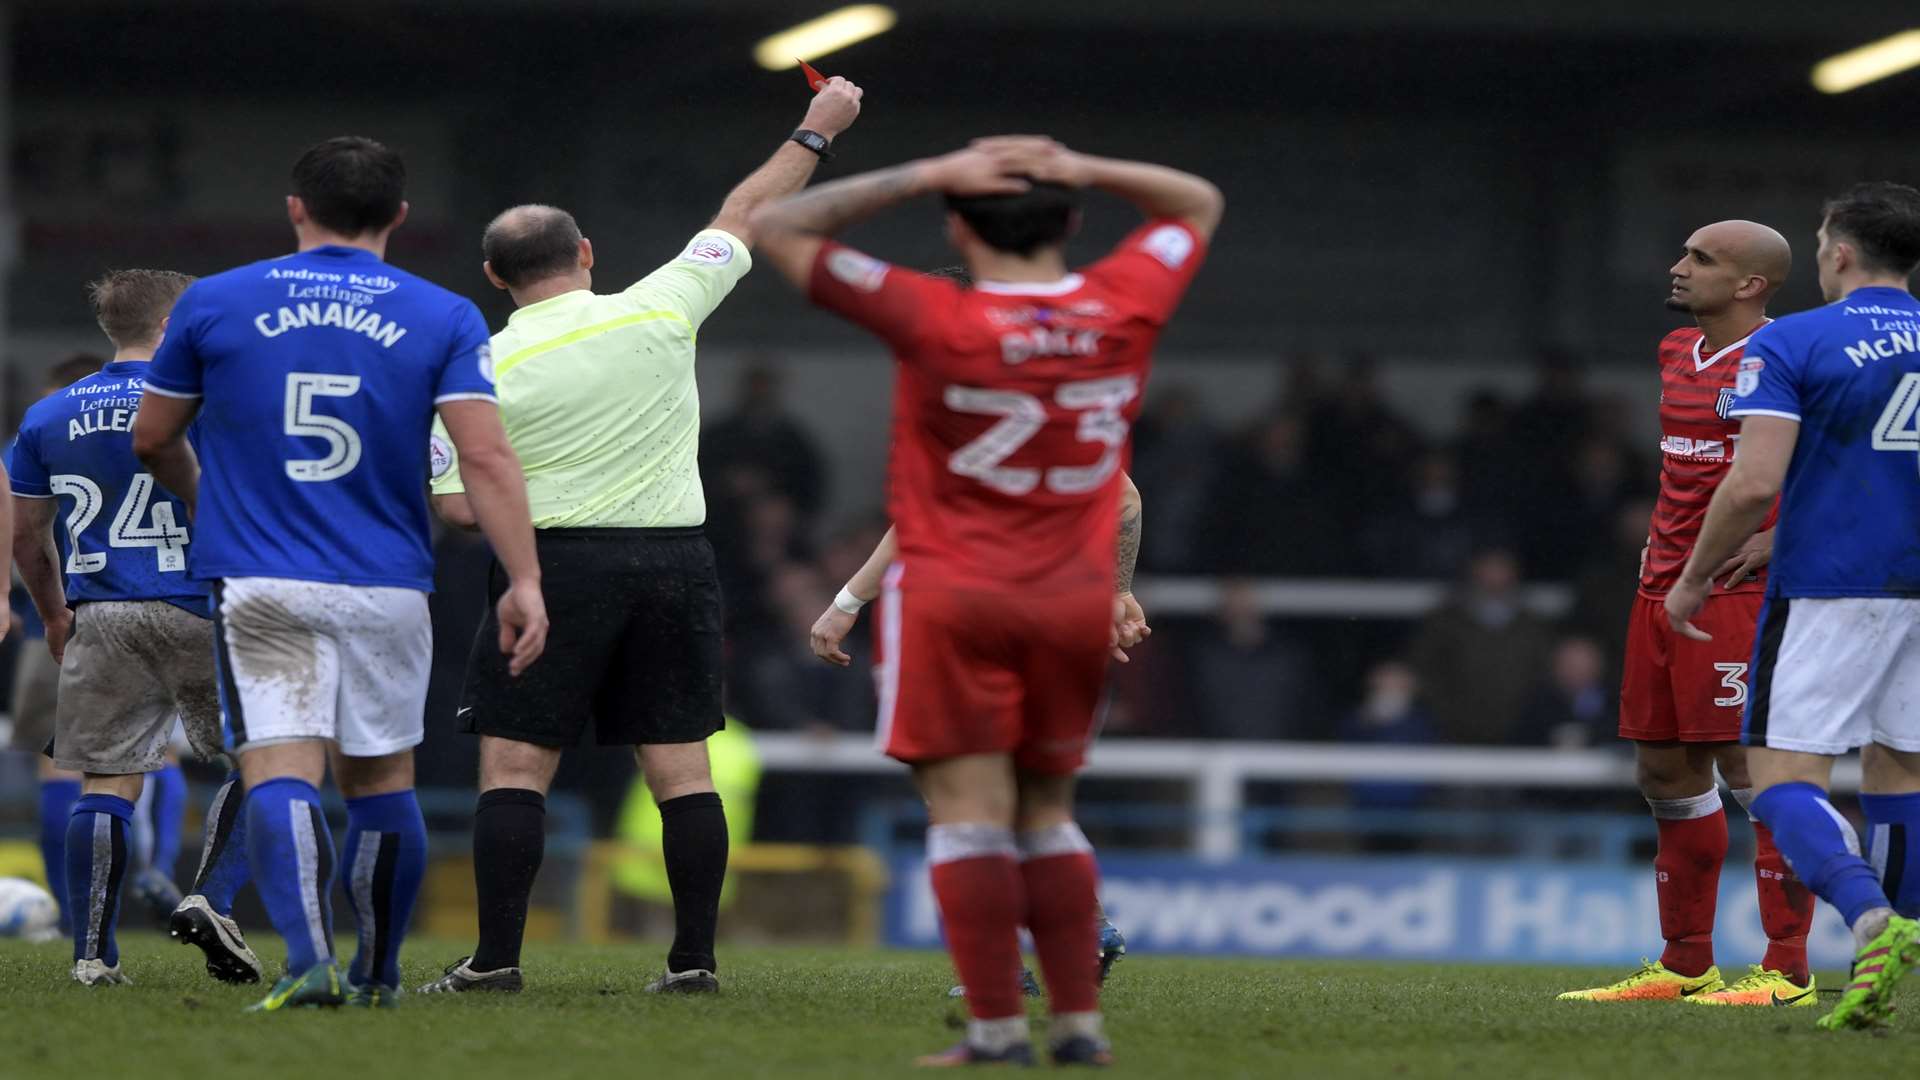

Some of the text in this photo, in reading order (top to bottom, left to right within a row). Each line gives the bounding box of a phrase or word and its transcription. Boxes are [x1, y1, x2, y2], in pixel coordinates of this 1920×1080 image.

[265, 268, 400, 294] Andrew Kelly
[288, 283, 374, 307] Lettings
[254, 302, 407, 348] CANAVAN
[1843, 305, 1914, 317] Andrew
[1870, 318, 1920, 332] Letti
[1844, 331, 1920, 368] McN
[65, 383, 124, 398] Andrew
[80, 396, 142, 412] Letting
[284, 372, 361, 481] 5
[943, 374, 1139, 495] 23
[50, 473, 190, 573] 24
[1714, 663, 1748, 706] 3
